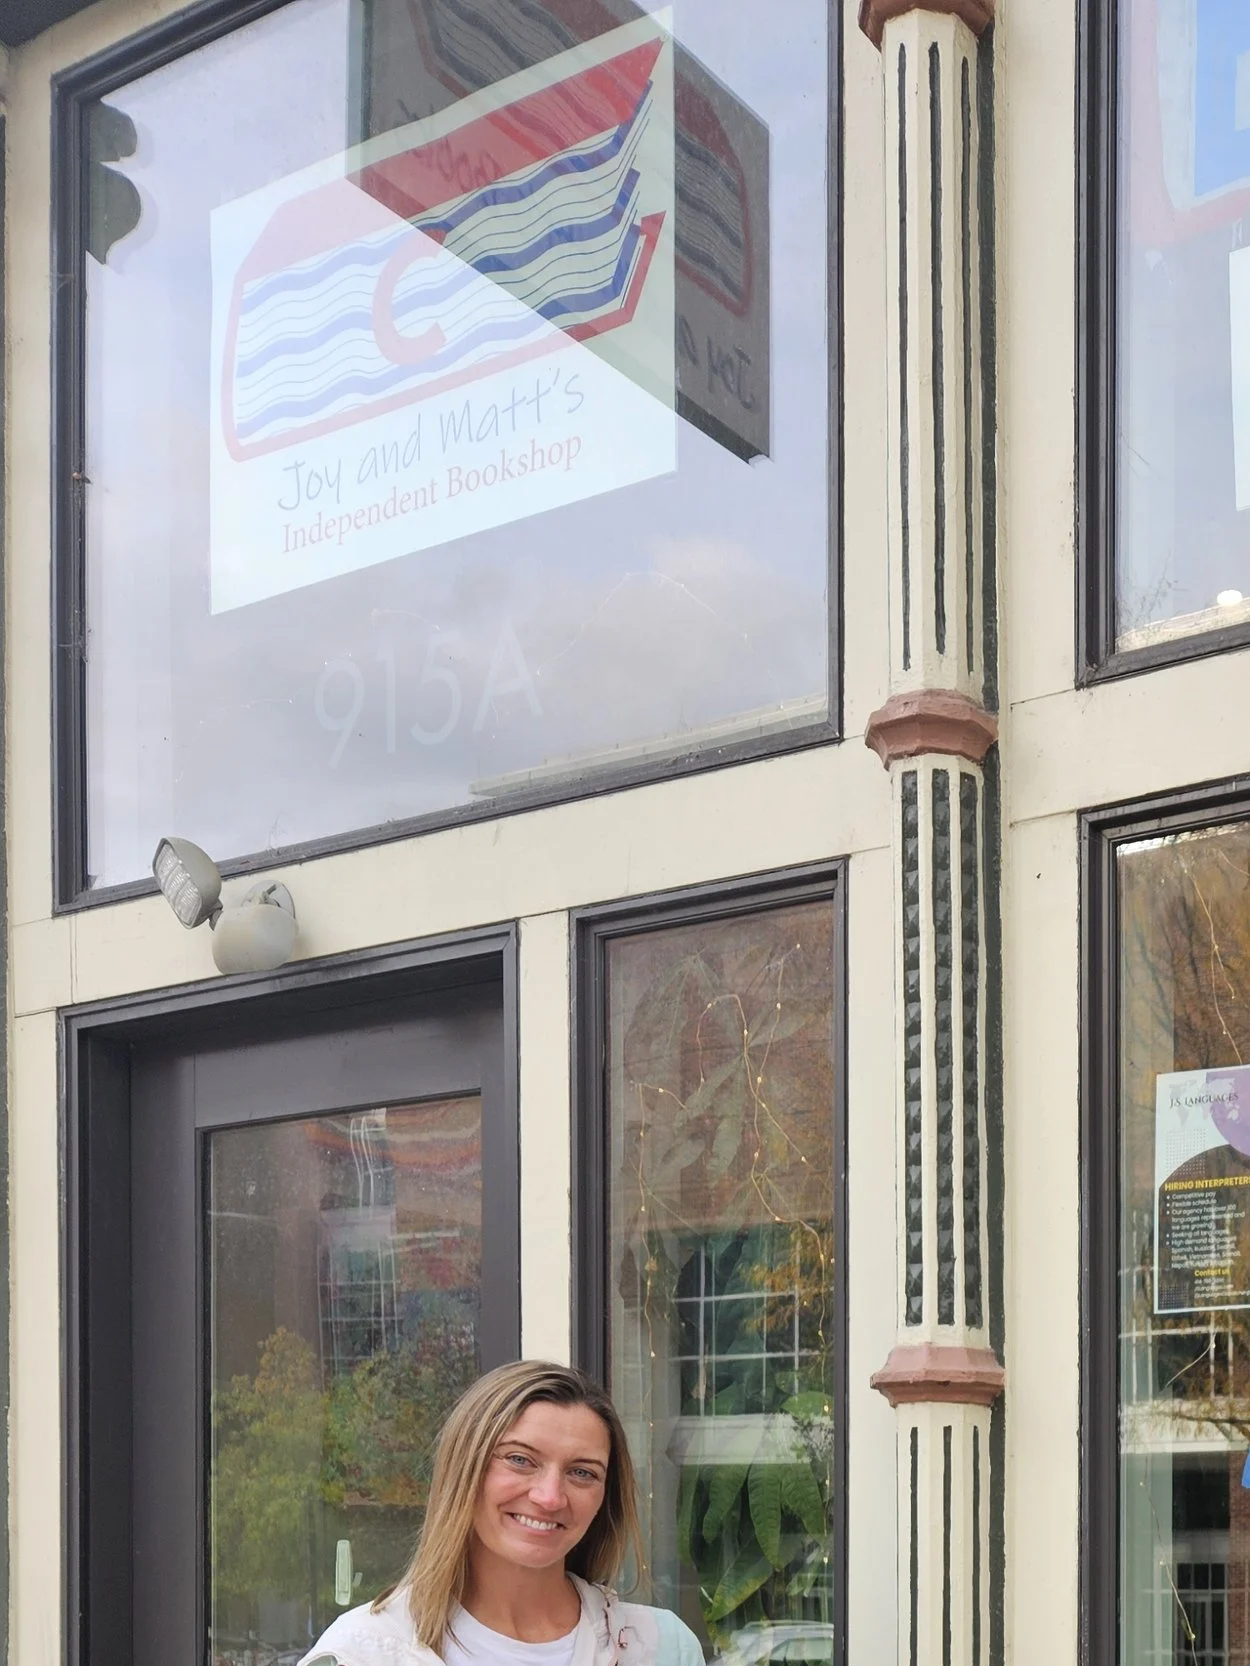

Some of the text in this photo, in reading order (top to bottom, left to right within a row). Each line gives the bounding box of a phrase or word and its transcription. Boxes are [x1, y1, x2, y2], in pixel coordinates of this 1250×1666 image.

[278, 367, 585, 511] Joy and Matt's
[282, 434, 583, 554] Independent Bookshop
[313, 614, 545, 771] 915A
[1185, 1092, 1239, 1108] LANGUAGES
